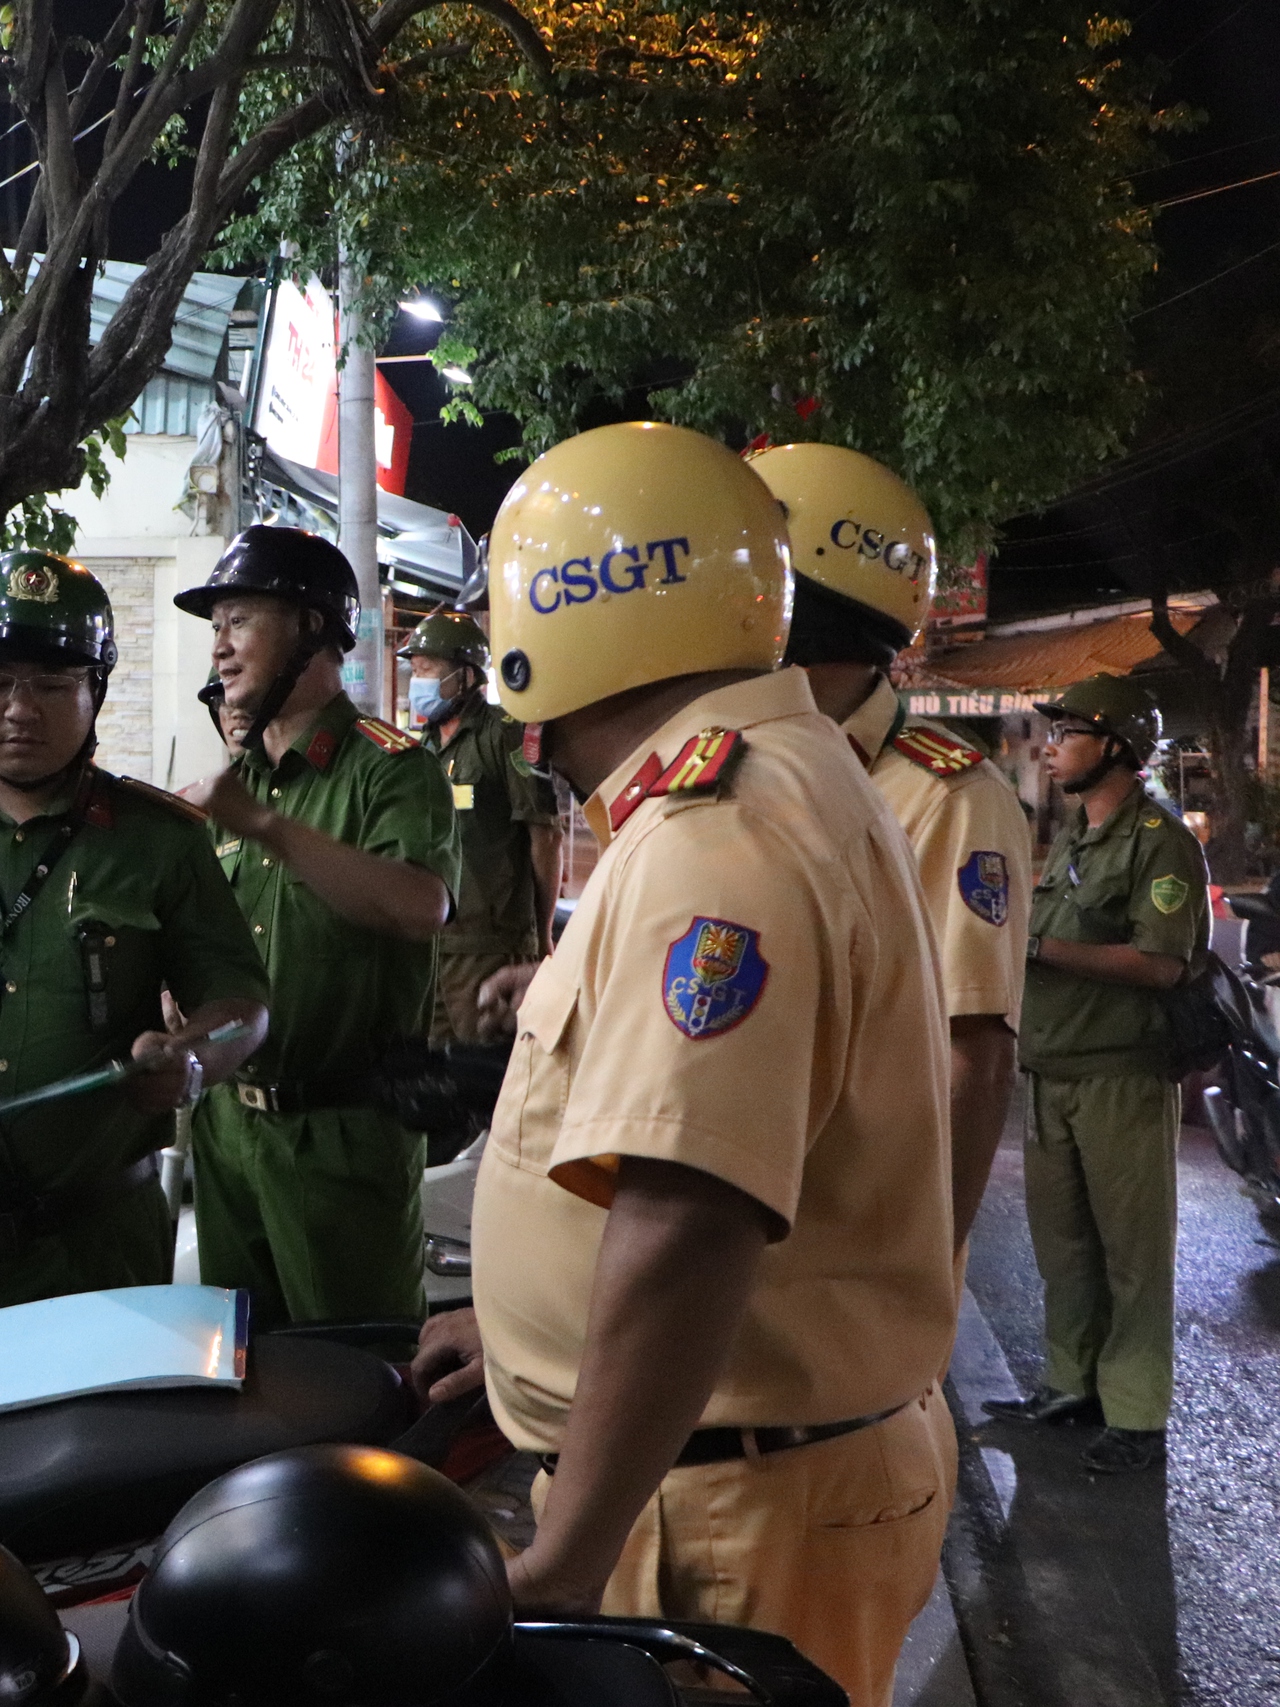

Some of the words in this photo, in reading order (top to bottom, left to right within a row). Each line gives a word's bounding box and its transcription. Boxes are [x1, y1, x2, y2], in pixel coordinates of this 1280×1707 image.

[830, 518, 925, 583] CSGT
[529, 536, 690, 615] CSGT
[909, 691, 941, 715] HỦ
[671, 976, 747, 1006] CSGT
